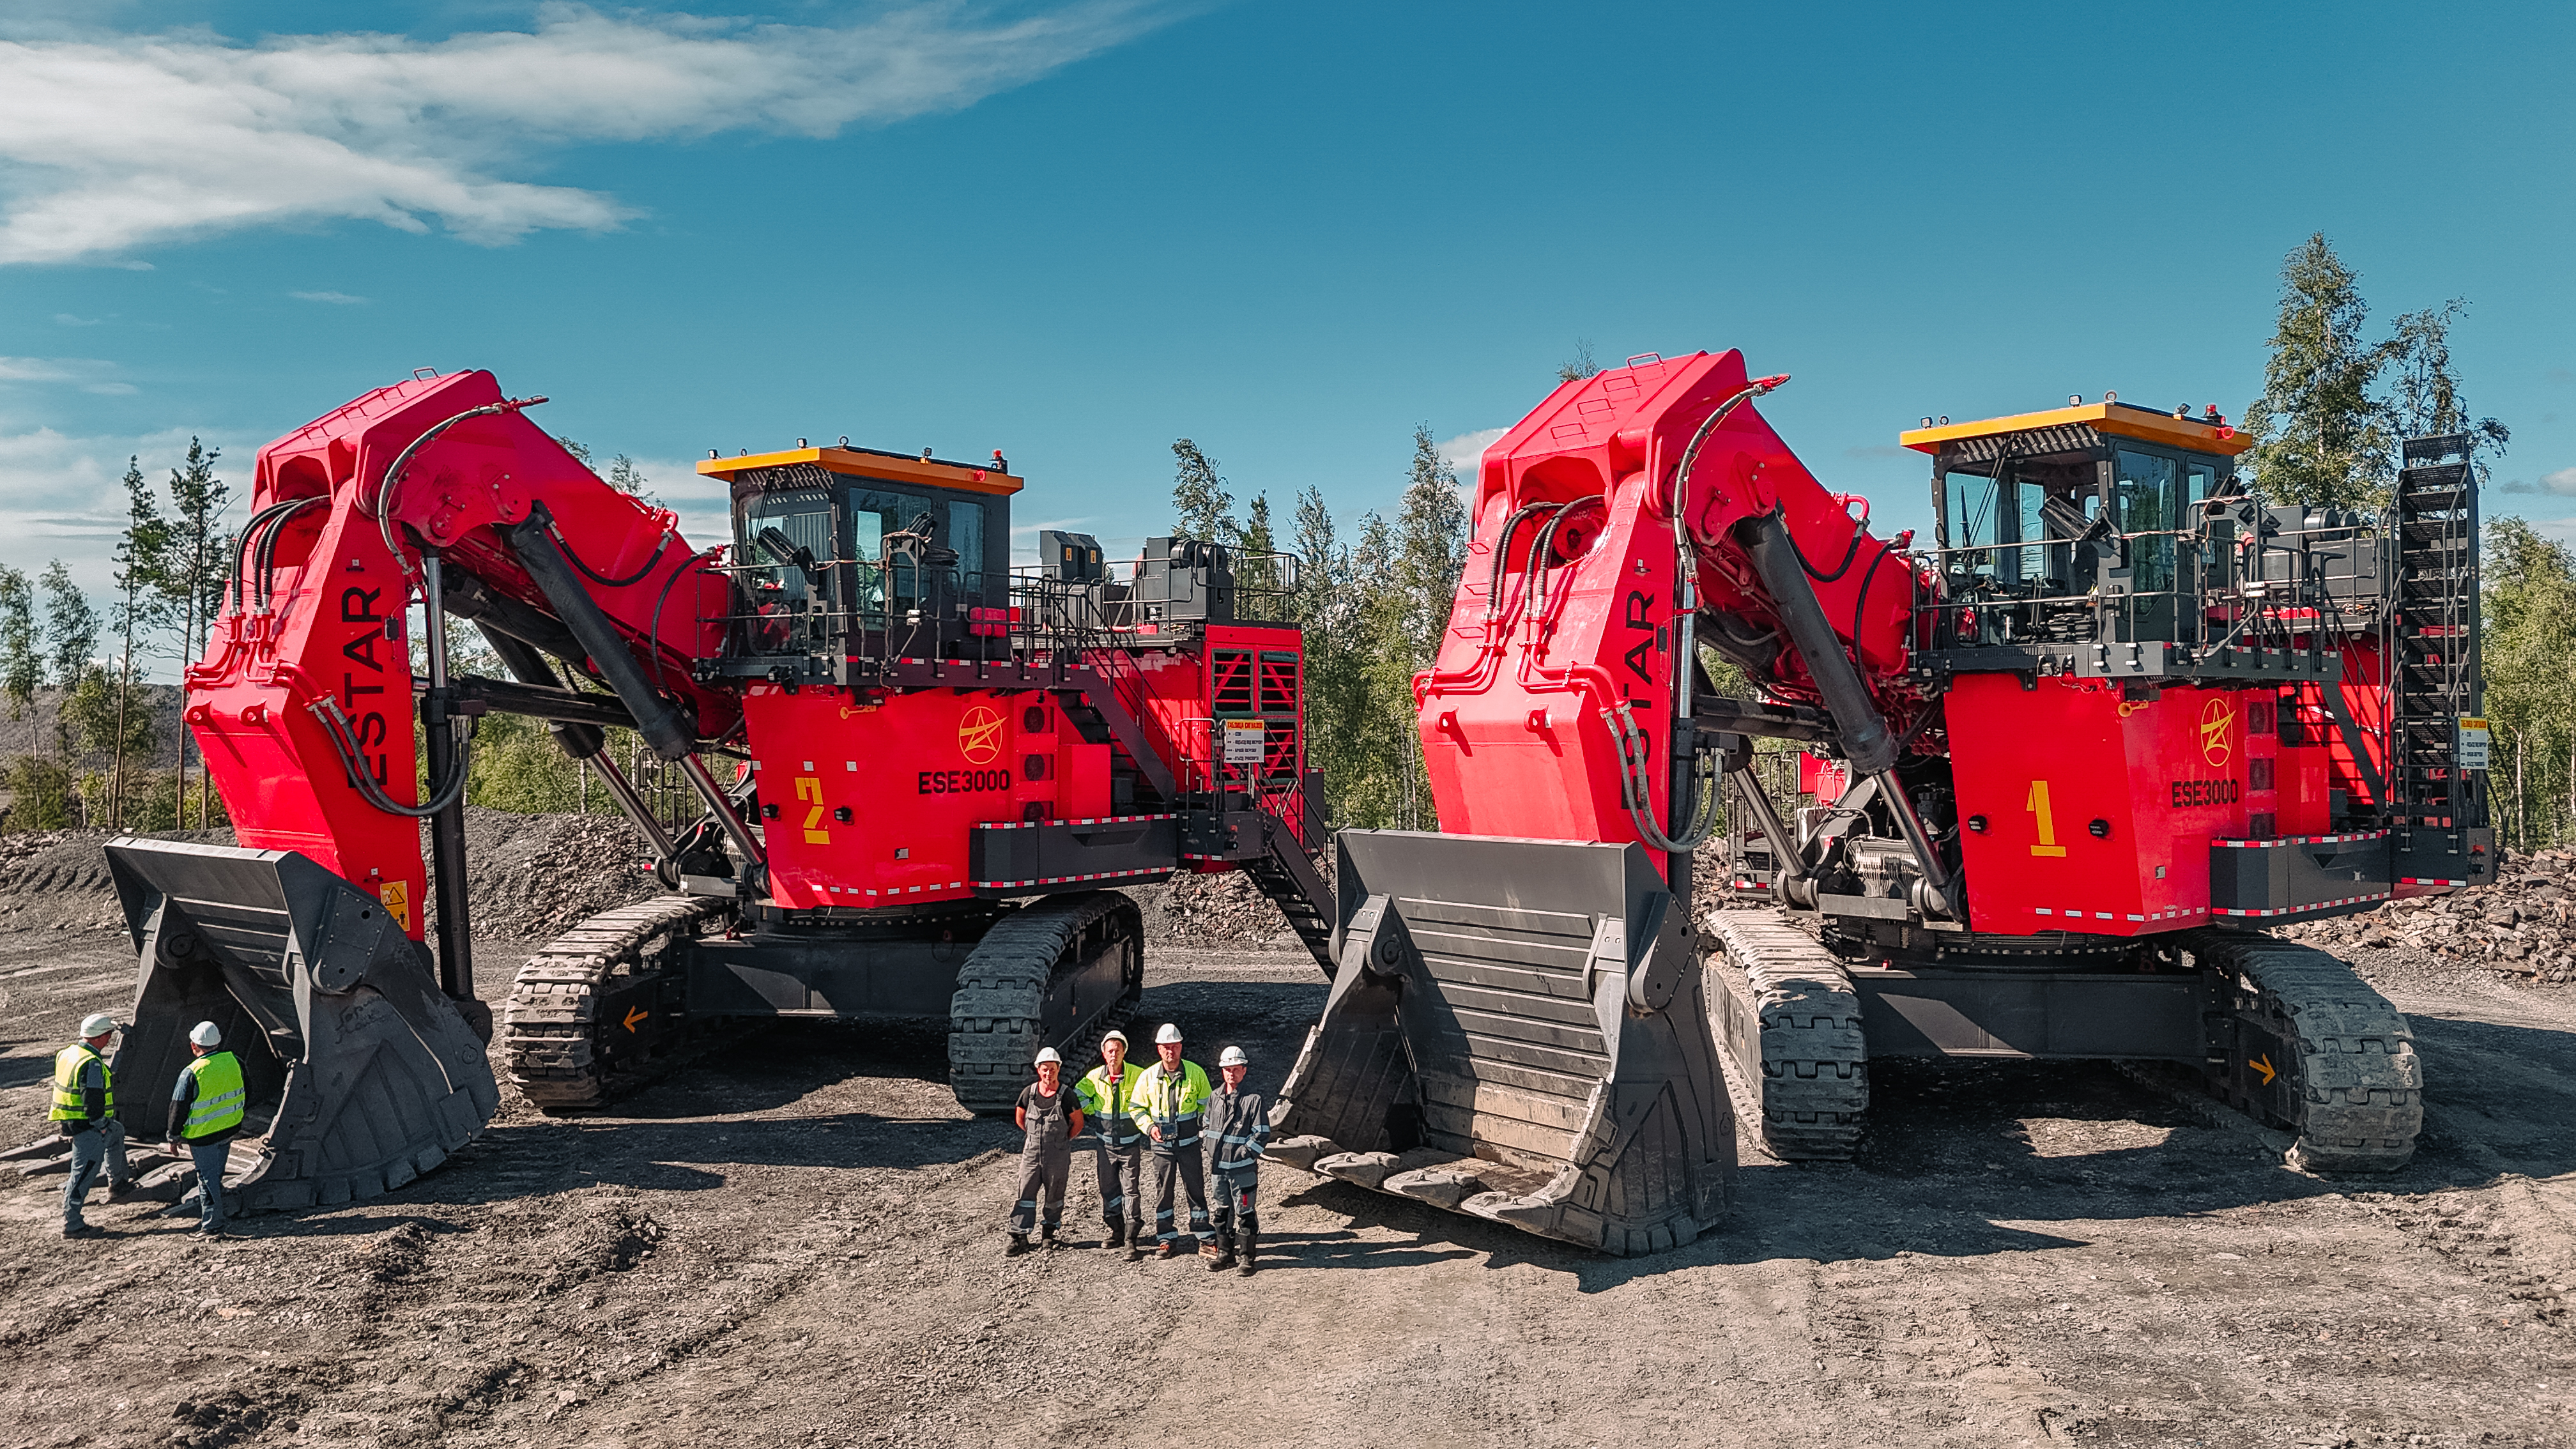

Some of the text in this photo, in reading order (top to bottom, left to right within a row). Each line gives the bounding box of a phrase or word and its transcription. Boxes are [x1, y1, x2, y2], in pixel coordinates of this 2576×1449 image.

[342, 587, 387, 787] ESTAR
[795, 778, 830, 843] 2
[919, 770, 1009, 793] ESE3000
[2173, 779, 2238, 808] ESE3000
[2027, 780, 2066, 857] 1
